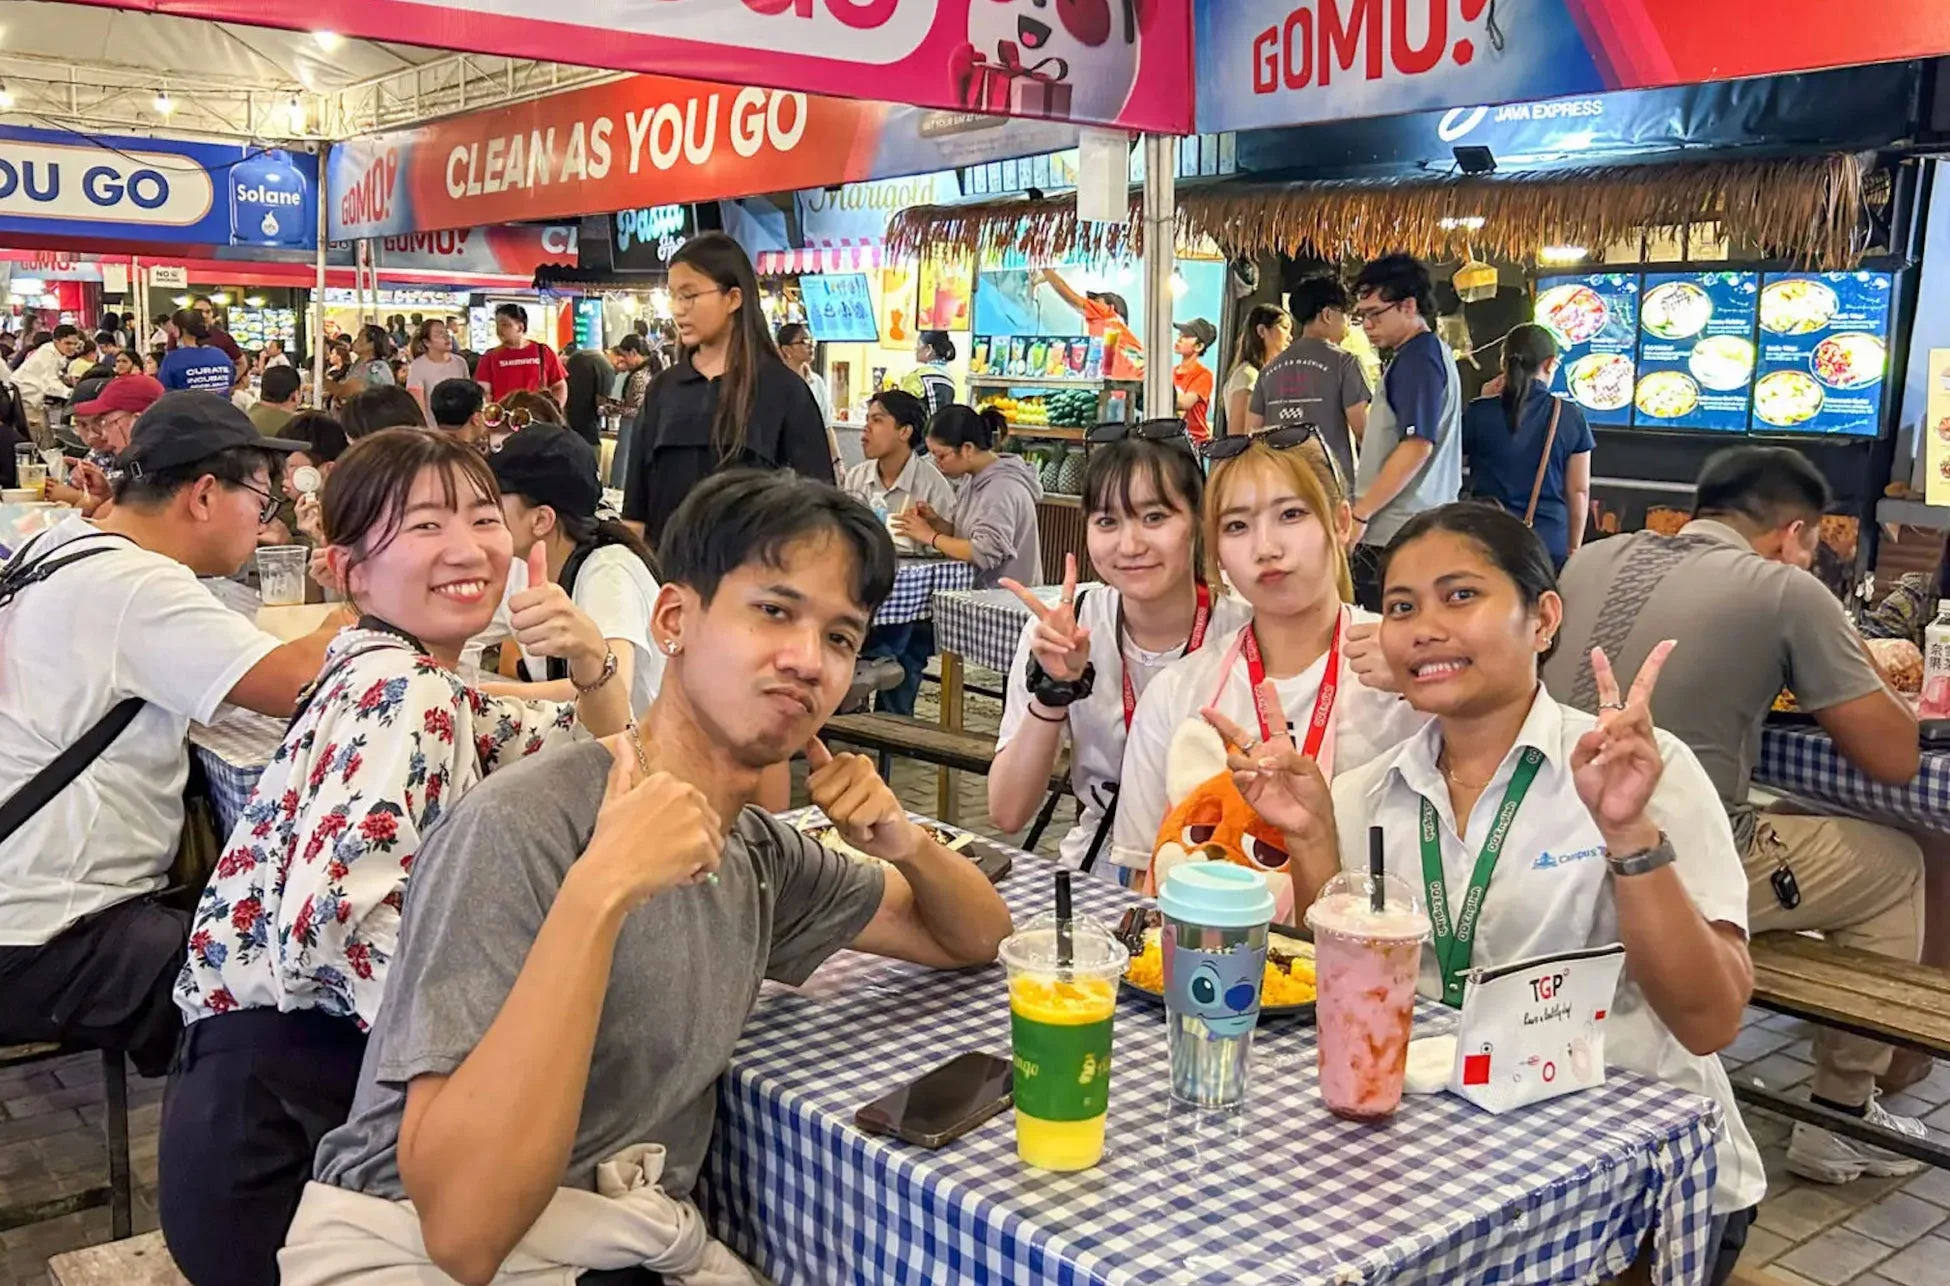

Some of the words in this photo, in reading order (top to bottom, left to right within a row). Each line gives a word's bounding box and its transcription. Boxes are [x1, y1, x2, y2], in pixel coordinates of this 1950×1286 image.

[1494, 105, 1529, 122] JAVA
[1533, 100, 1603, 119] EXPRESS
[446, 127, 555, 199] CLEAN
[559, 116, 613, 183] AS
[625, 94, 719, 174] YOU
[730, 86, 808, 157] GO
[83, 166, 169, 210] GO
[237, 184, 301, 206] Solane
[341, 147, 399, 226] GOMO!
[186, 366, 230, 376] CURATE
[1529, 974, 1563, 1002] TGP
